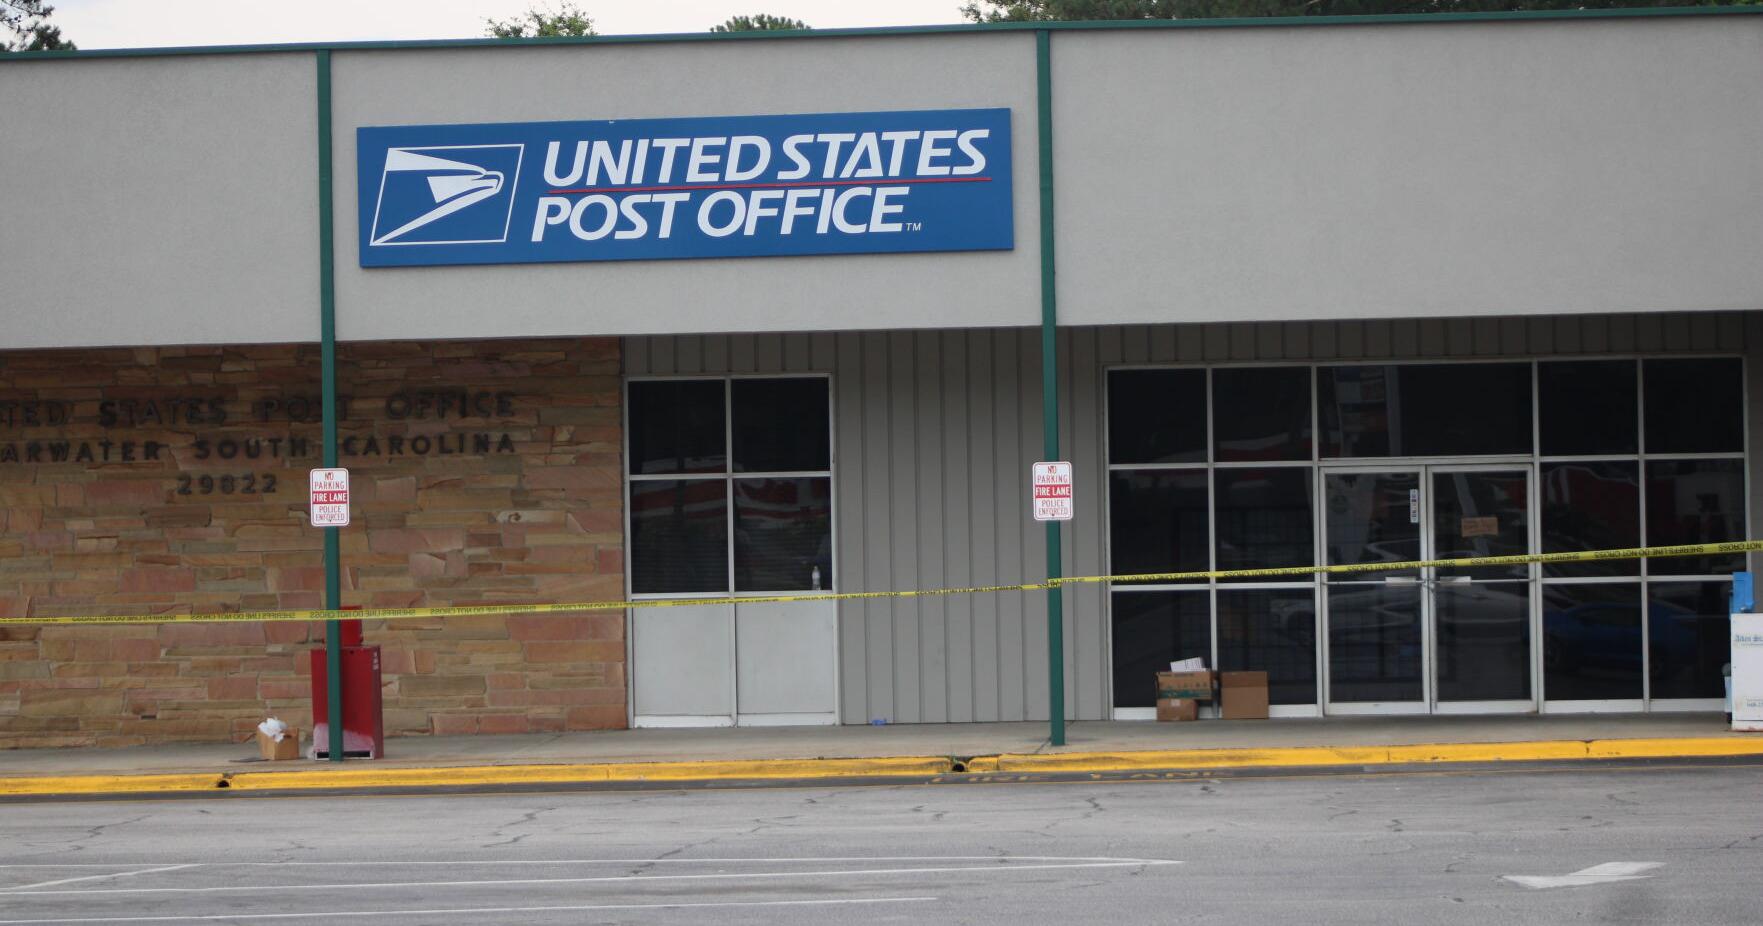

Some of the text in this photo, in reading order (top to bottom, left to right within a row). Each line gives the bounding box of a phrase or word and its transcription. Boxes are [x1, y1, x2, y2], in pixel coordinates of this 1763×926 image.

[543, 129, 990, 187] UNITED STATES
[531, 191, 691, 242] POST
[698, 187, 909, 237] OFFICE
[0, 400, 67, 428] TED
[98, 396, 227, 427] STATES
[385, 389, 516, 420] OFFICE
[0, 433, 516, 463] ARWATER SOUTH CAROLINA
[1048, 466, 1056, 474] NO
[325, 472, 333, 480] NO
[1037, 475, 1068, 483] PARKING
[177, 473, 277, 496] 29822
[314, 481, 344, 489] PARKING
[1036, 487, 1070, 496] FIRE LANE
[313, 493, 347, 501] FIRE LANE
